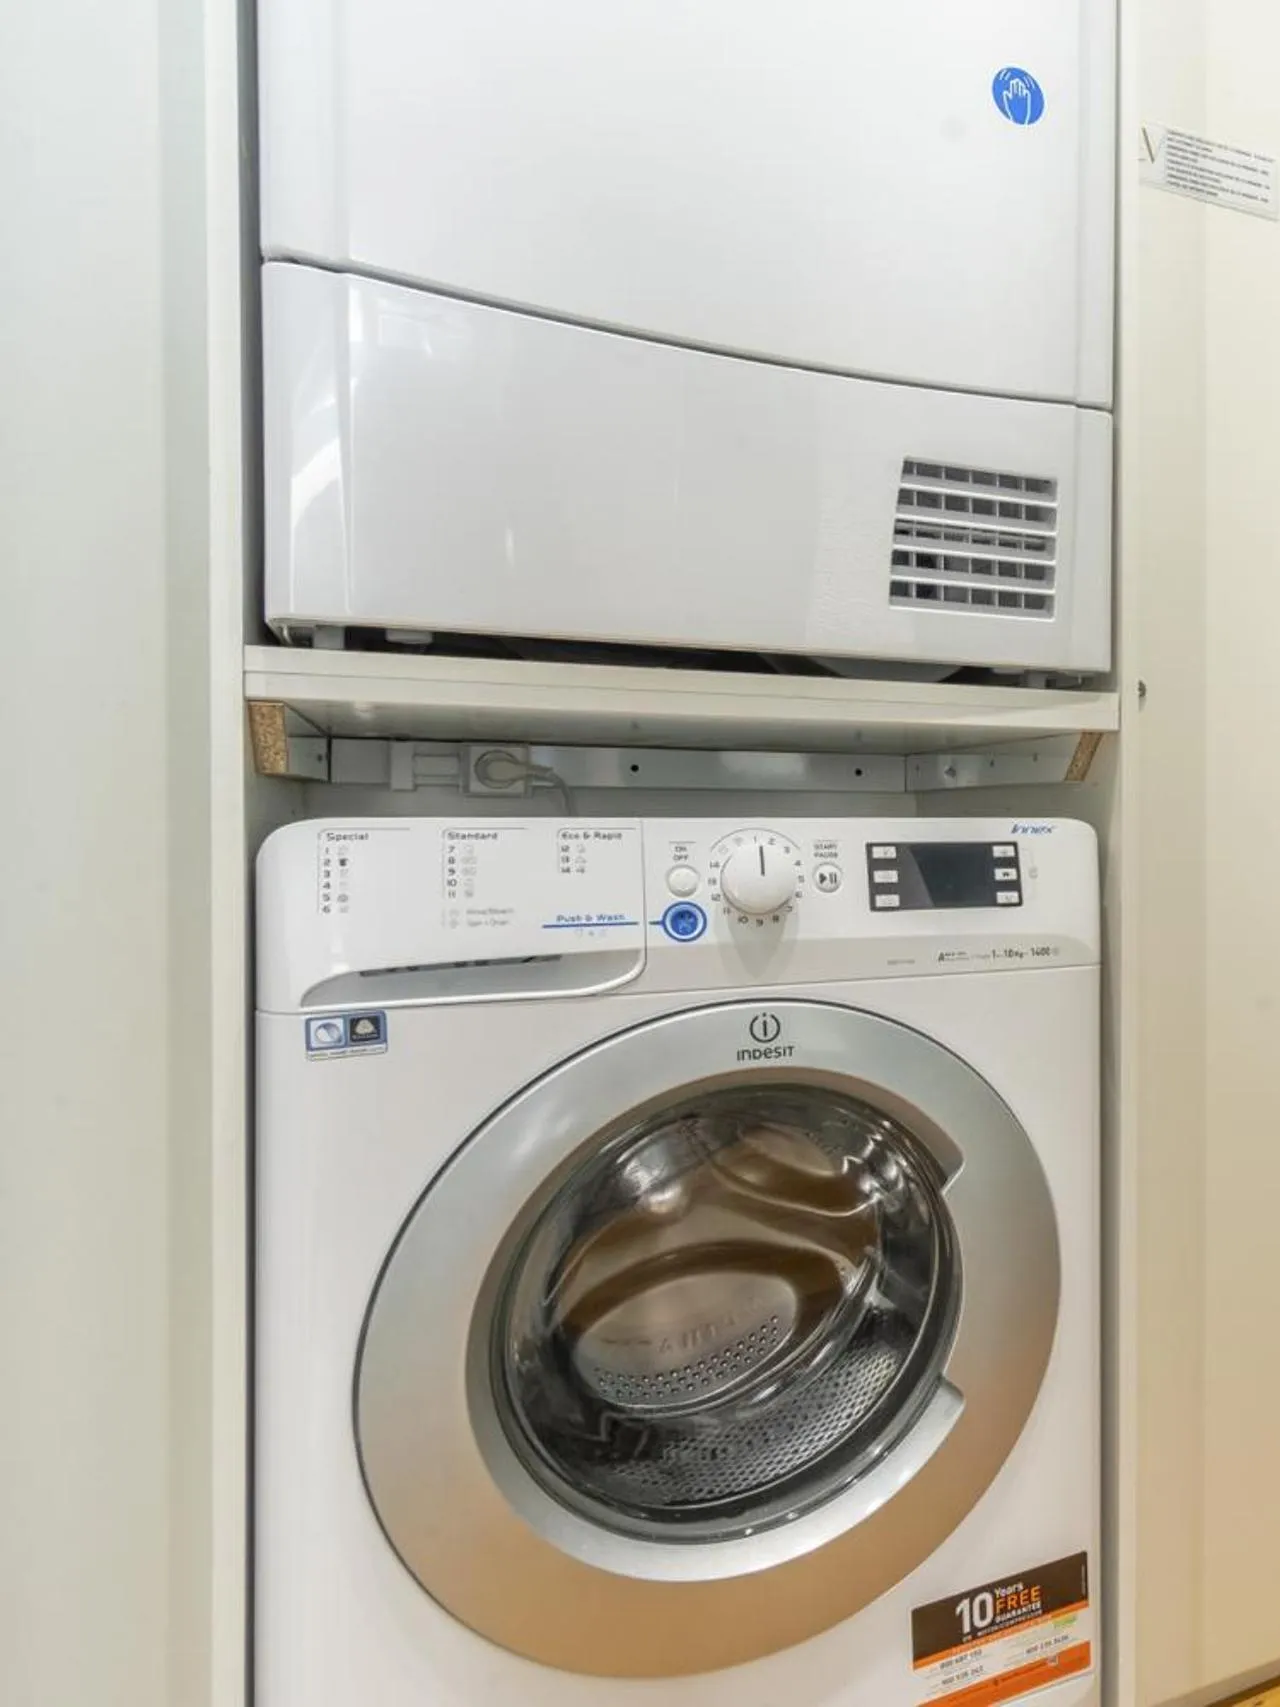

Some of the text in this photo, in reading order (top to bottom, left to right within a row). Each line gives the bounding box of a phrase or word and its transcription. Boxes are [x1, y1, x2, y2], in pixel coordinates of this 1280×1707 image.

[326, 832, 369, 842] Special
[447, 831, 498, 841] Standard
[594, 831, 622, 841] Rapid
[672, 853, 689, 862] OFF
[556, 914, 582, 923] Push
[596, 913, 626, 922] Wash
[995, 1584, 1042, 1614] FREE
[955, 1591, 995, 1636] 10
[994, 1581, 1025, 1599] Years
